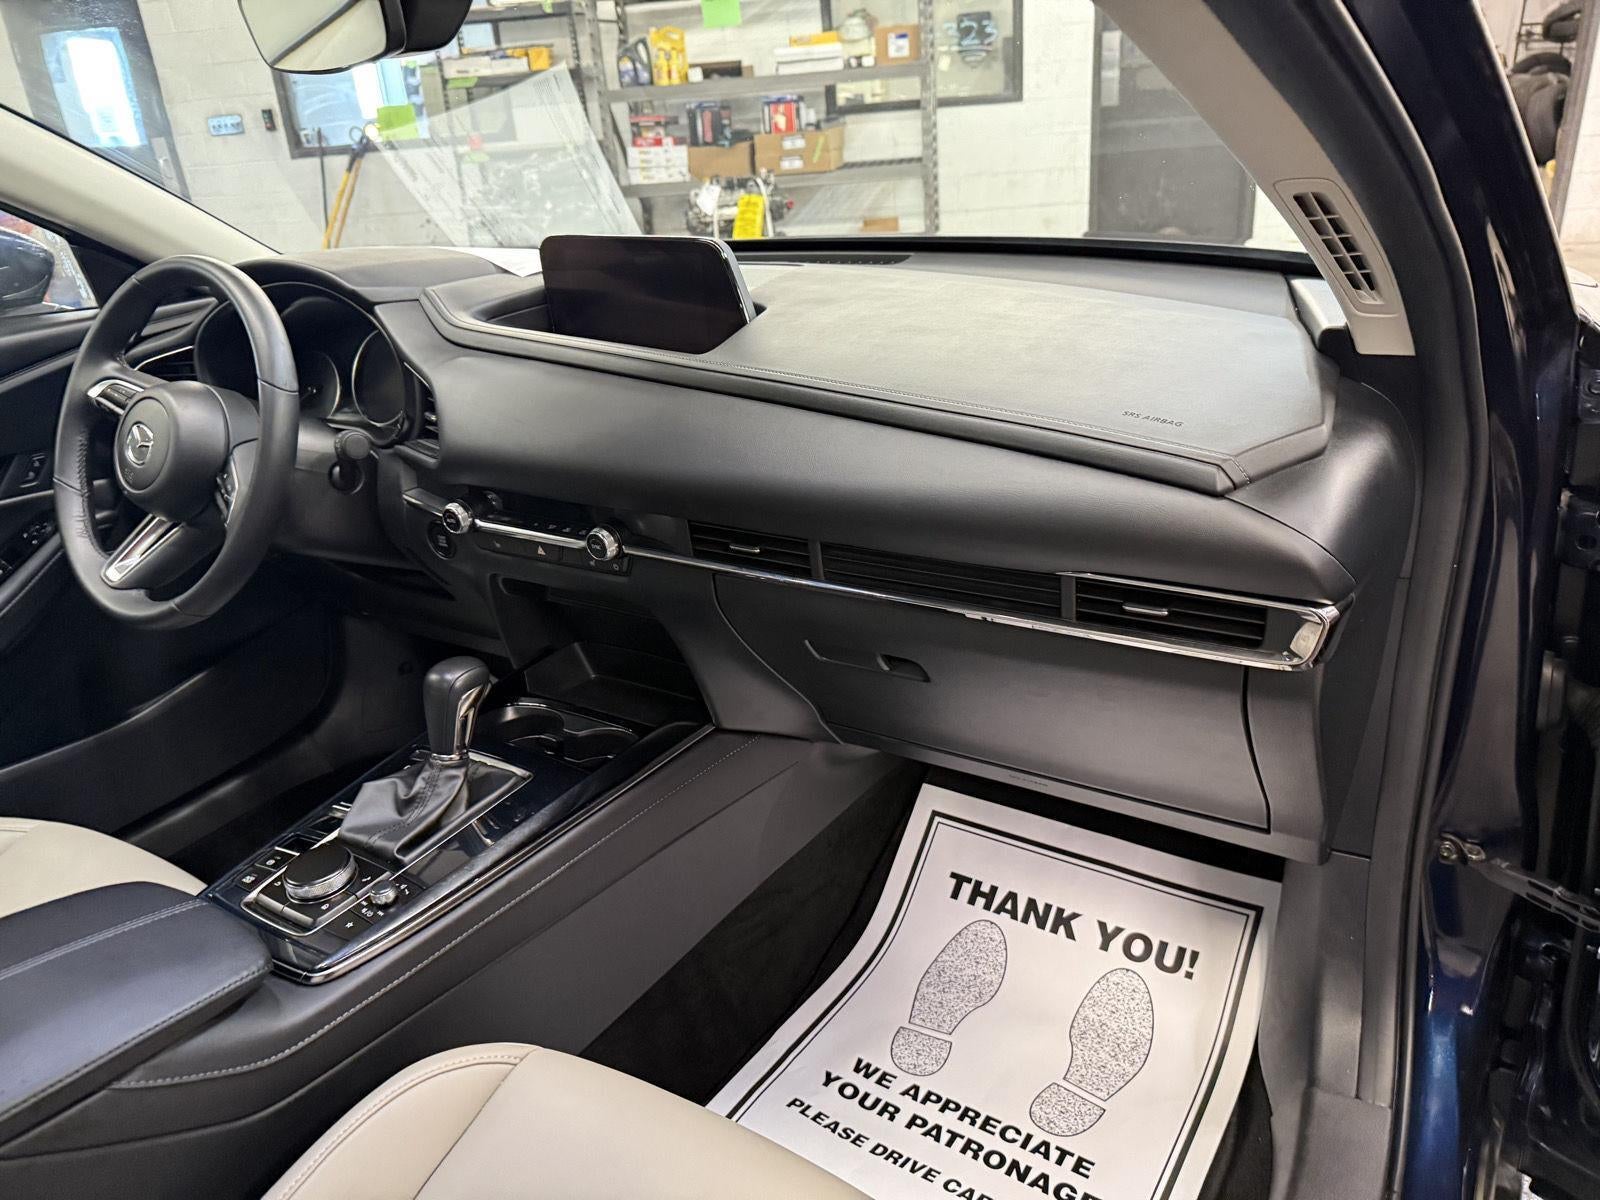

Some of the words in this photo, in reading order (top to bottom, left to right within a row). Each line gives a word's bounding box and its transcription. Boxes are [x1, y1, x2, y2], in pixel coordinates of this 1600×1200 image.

[1121, 410, 1141, 419] SRS
[1141, 415, 1184, 427] AIRBAG
[949, 871, 1083, 942] THANK
[1096, 919, 1200, 980] YOU!
[820, 1070, 902, 1123] YOUR
[852, 1056, 898, 1090] WE
[899, 1083, 1096, 1180] APPRECIATE
[785, 1097, 870, 1148] PLEASE
[869, 1142, 942, 1183] DRIVE
